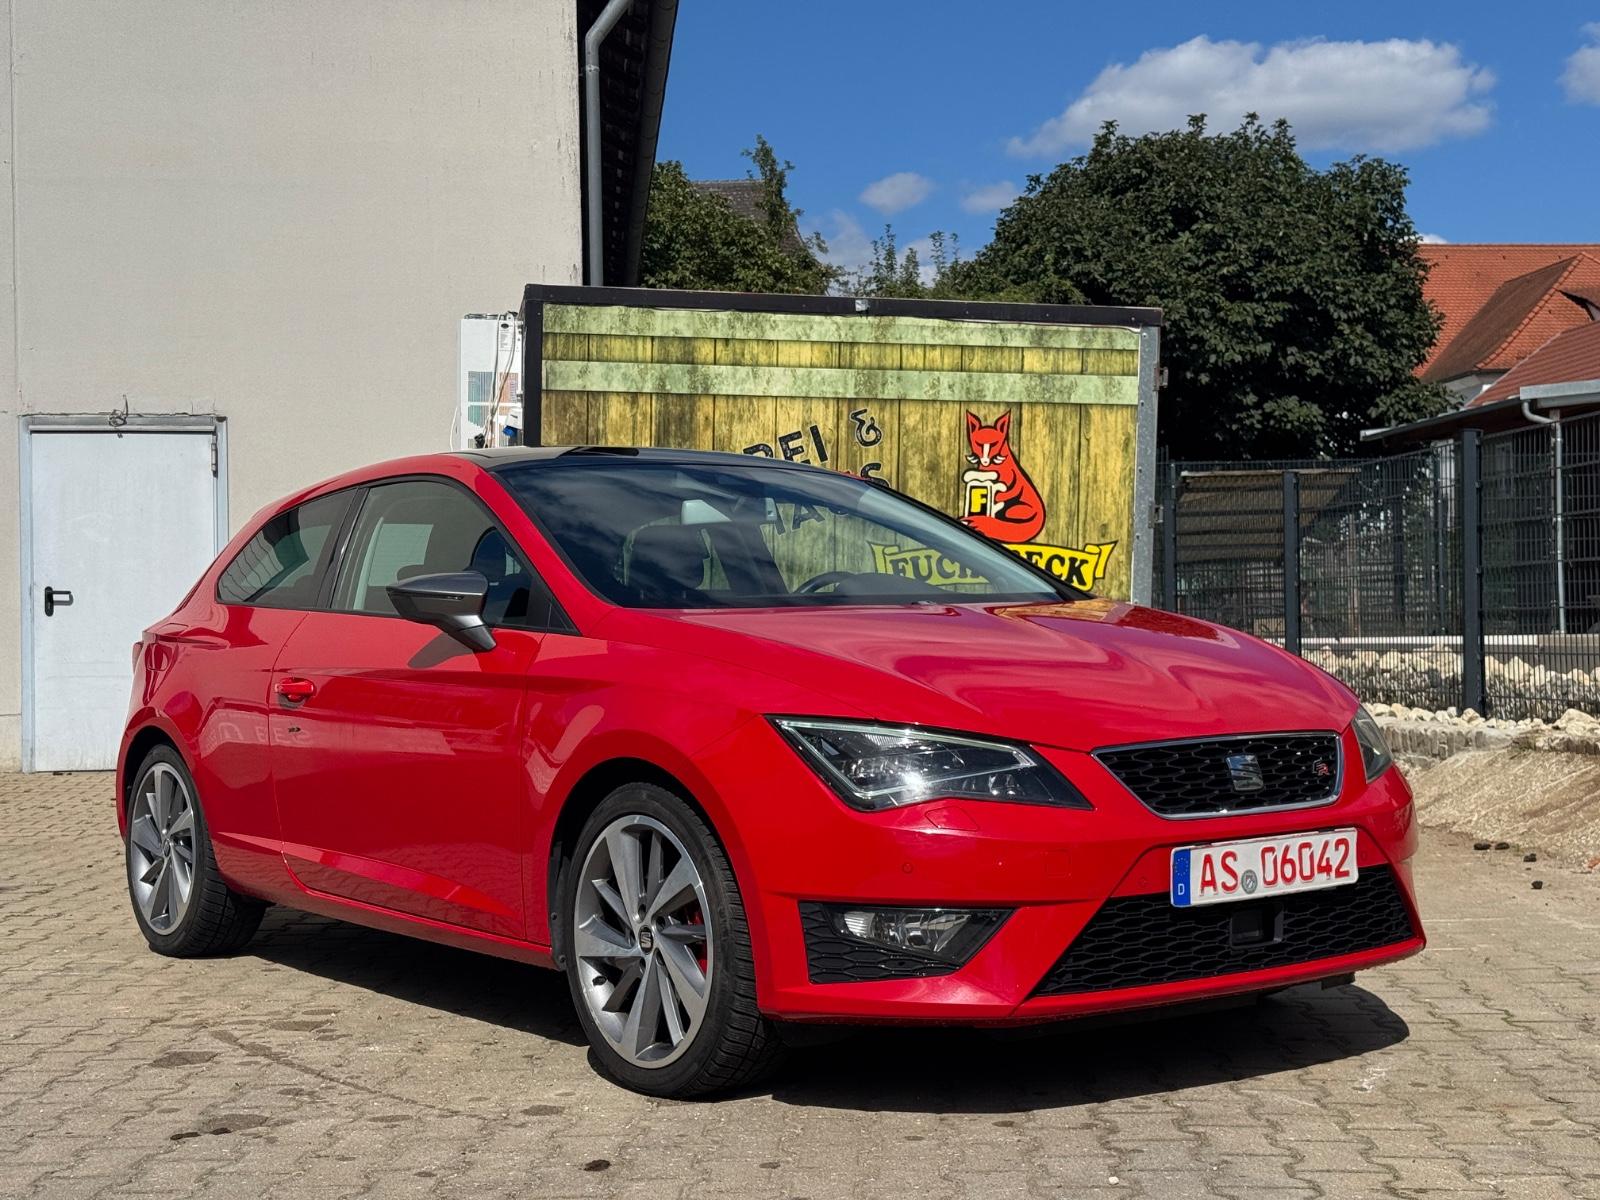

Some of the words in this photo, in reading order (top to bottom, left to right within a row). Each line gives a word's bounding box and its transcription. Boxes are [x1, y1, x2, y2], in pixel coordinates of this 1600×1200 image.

[970, 488, 987, 513] F
[1200, 851, 1239, 895] AS
[1260, 838, 1350, 886] 06042
[1177, 883, 1185, 896] D
